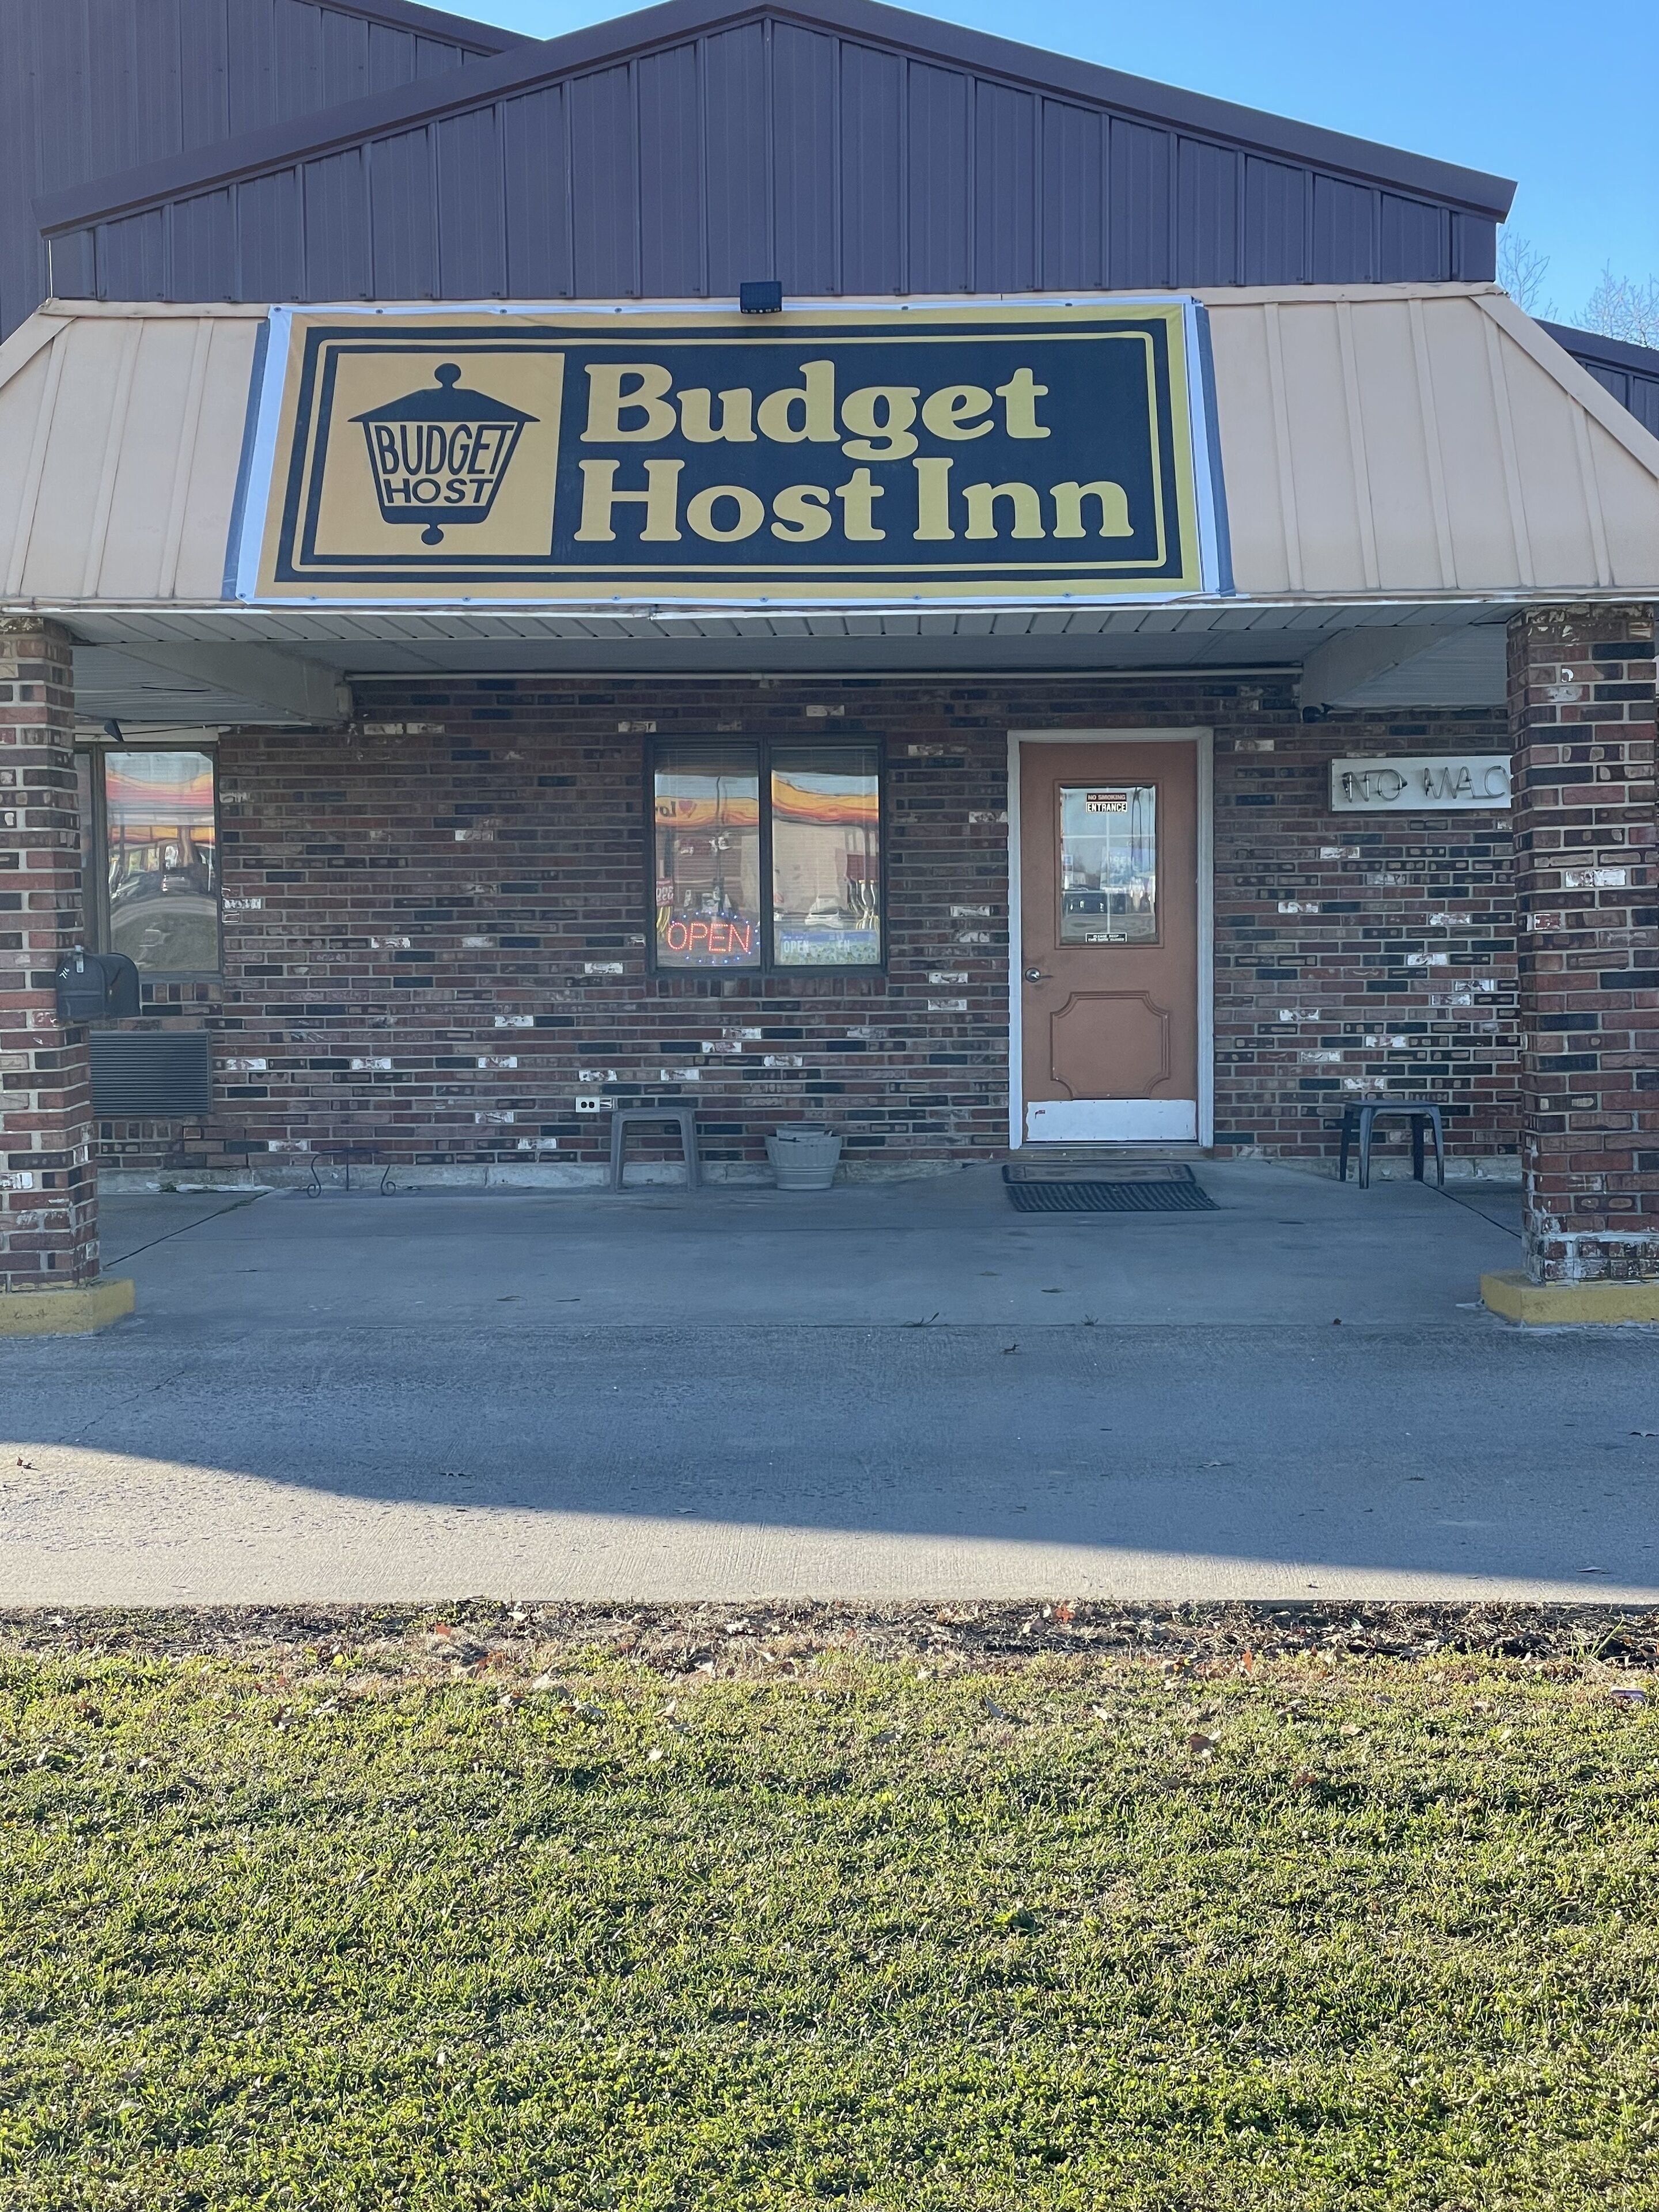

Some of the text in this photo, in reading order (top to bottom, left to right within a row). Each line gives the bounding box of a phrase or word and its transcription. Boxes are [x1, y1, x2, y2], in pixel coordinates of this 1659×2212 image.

[580, 359, 1051, 460] Budget
[374, 423, 515, 476] BUDGET
[383, 478, 494, 504] HOST
[575, 457, 1134, 543] Host Inn
[1343, 768, 1406, 802] NO
[1087, 803, 1126, 812] ENTRANCE
[668, 922, 750, 955] OPEN
[783, 940, 809, 953] OPEN
[59, 968, 70, 979] 716
